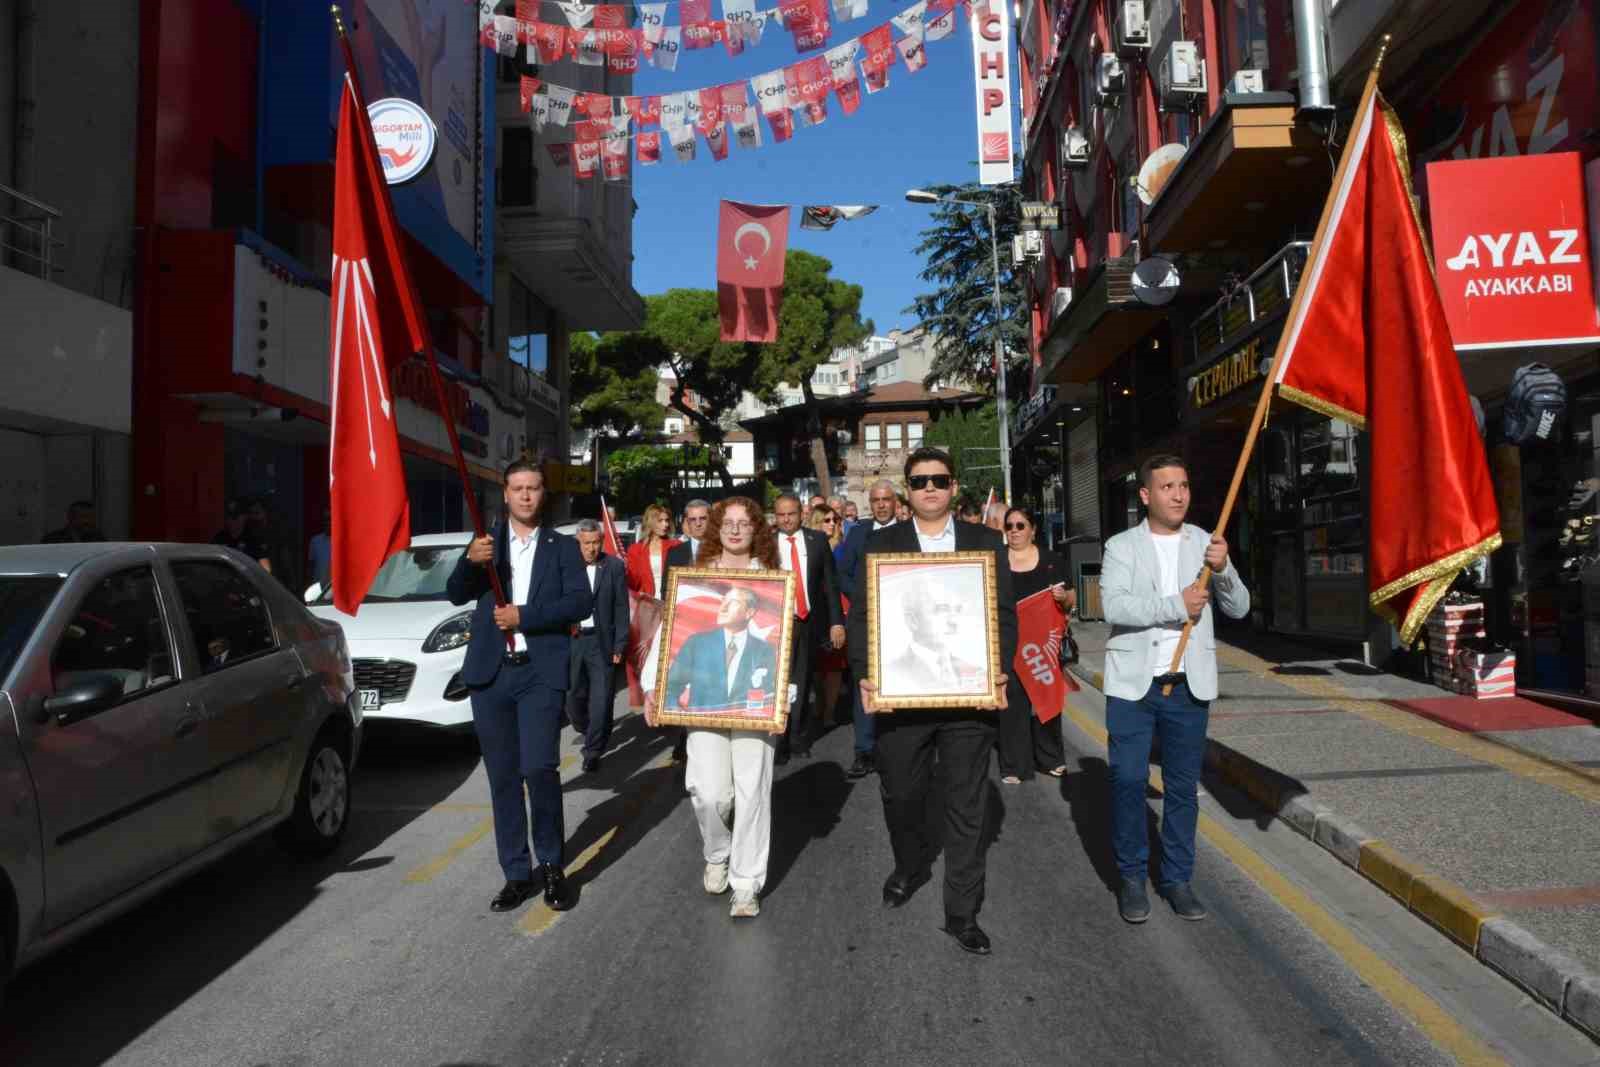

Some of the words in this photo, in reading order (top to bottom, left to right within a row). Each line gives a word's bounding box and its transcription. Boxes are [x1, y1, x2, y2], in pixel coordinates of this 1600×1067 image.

[979, 14, 1004, 116] CHP
[765, 84, 787, 97] CHP
[548, 97, 570, 110] CHP
[662, 103, 684, 114] CHP
[1446, 229, 1581, 271] AYAZ
[1465, 275, 1573, 297] AYAKKABI
[1022, 643, 1055, 685] CHP
[360, 691, 377, 705] 72
